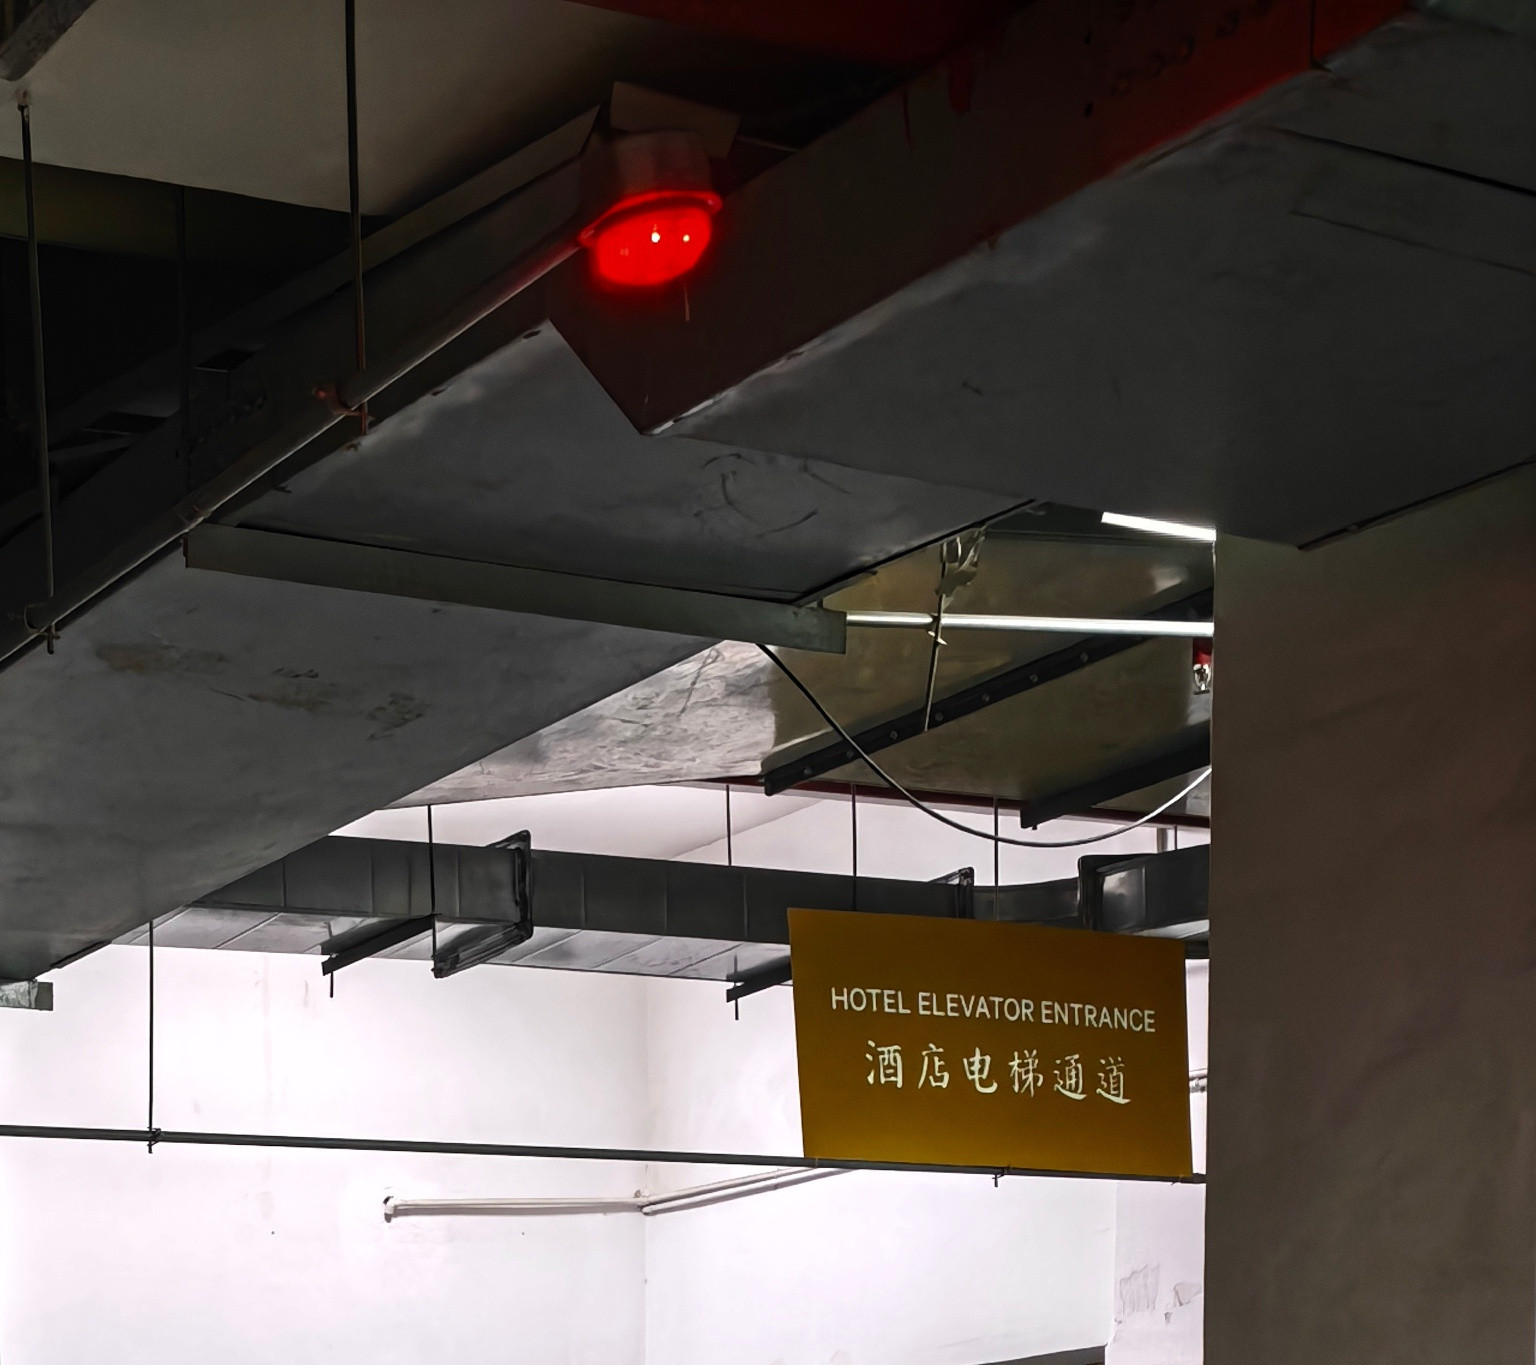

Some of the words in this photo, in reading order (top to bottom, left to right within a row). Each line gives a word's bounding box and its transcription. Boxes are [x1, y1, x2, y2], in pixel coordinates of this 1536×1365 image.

[831, 986, 911, 1015] HOTEL
[918, 992, 1034, 1023] ELEVATOR
[1041, 1000, 1156, 1033] ENTRANCE
[866, 1039, 1131, 1105] 酒店电梯通道
